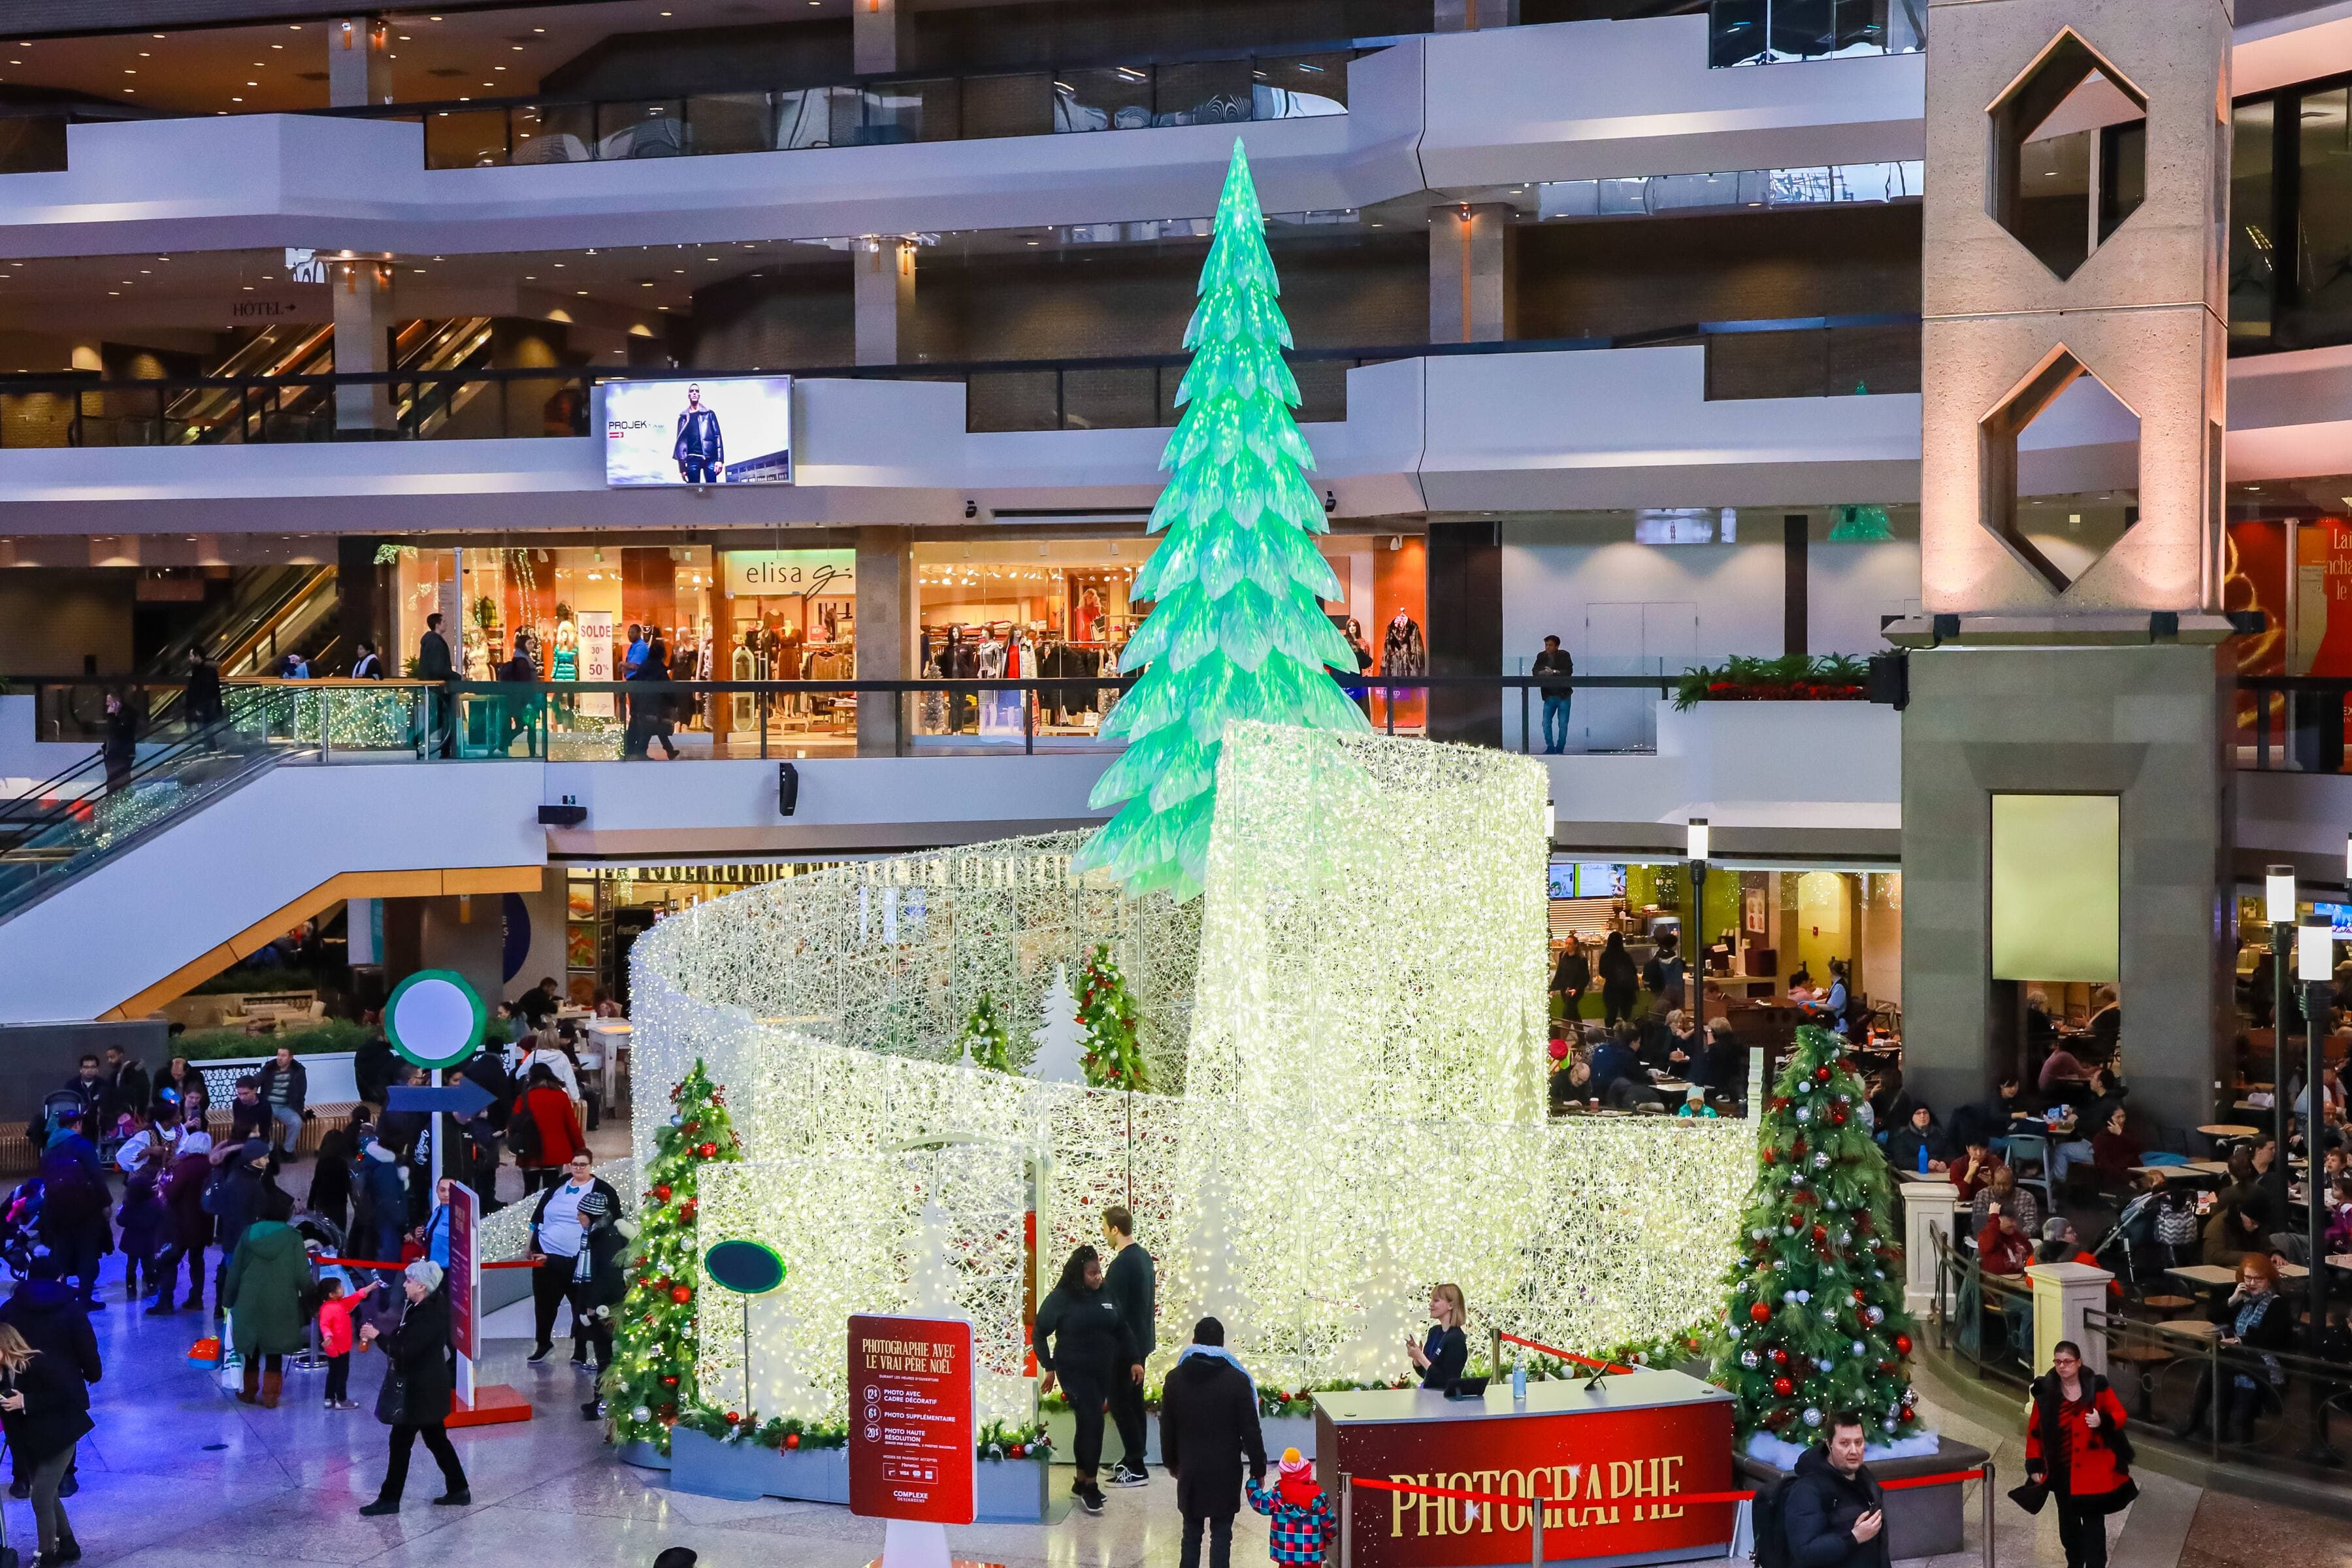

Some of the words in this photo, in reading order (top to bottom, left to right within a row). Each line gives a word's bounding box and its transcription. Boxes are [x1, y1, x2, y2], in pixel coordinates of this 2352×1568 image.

[233, 300, 284, 316] HÔTEL
[608, 420, 647, 429] PROJEK
[746, 562, 801, 583] elisa
[580, 625, 611, 638] SOLDE
[589, 664, 609, 675] 50%
[862, 1338, 929, 1357] PHOTOGRAPHIE
[932, 1343, 956, 1358] AVEC
[866, 1354, 877, 1369] LE
[880, 1355, 902, 1370] VRAI
[905, 1355, 926, 1373] PÈRE
[930, 1358, 952, 1374] NOËL
[867, 1388, 877, 1399] 12$
[905, 1396, 938, 1405] DÉCORATIF
[868, 1408, 877, 1418] 6$
[906, 1412, 956, 1422] SUPPLÉMENTAIRE
[867, 1428, 879, 1438] 20$
[885, 1433, 921, 1443] RÉSOLUTION
[893, 1490, 928, 1499] COMPLEXE
[1390, 1456, 1684, 1537] PHOTOGRAPHE
